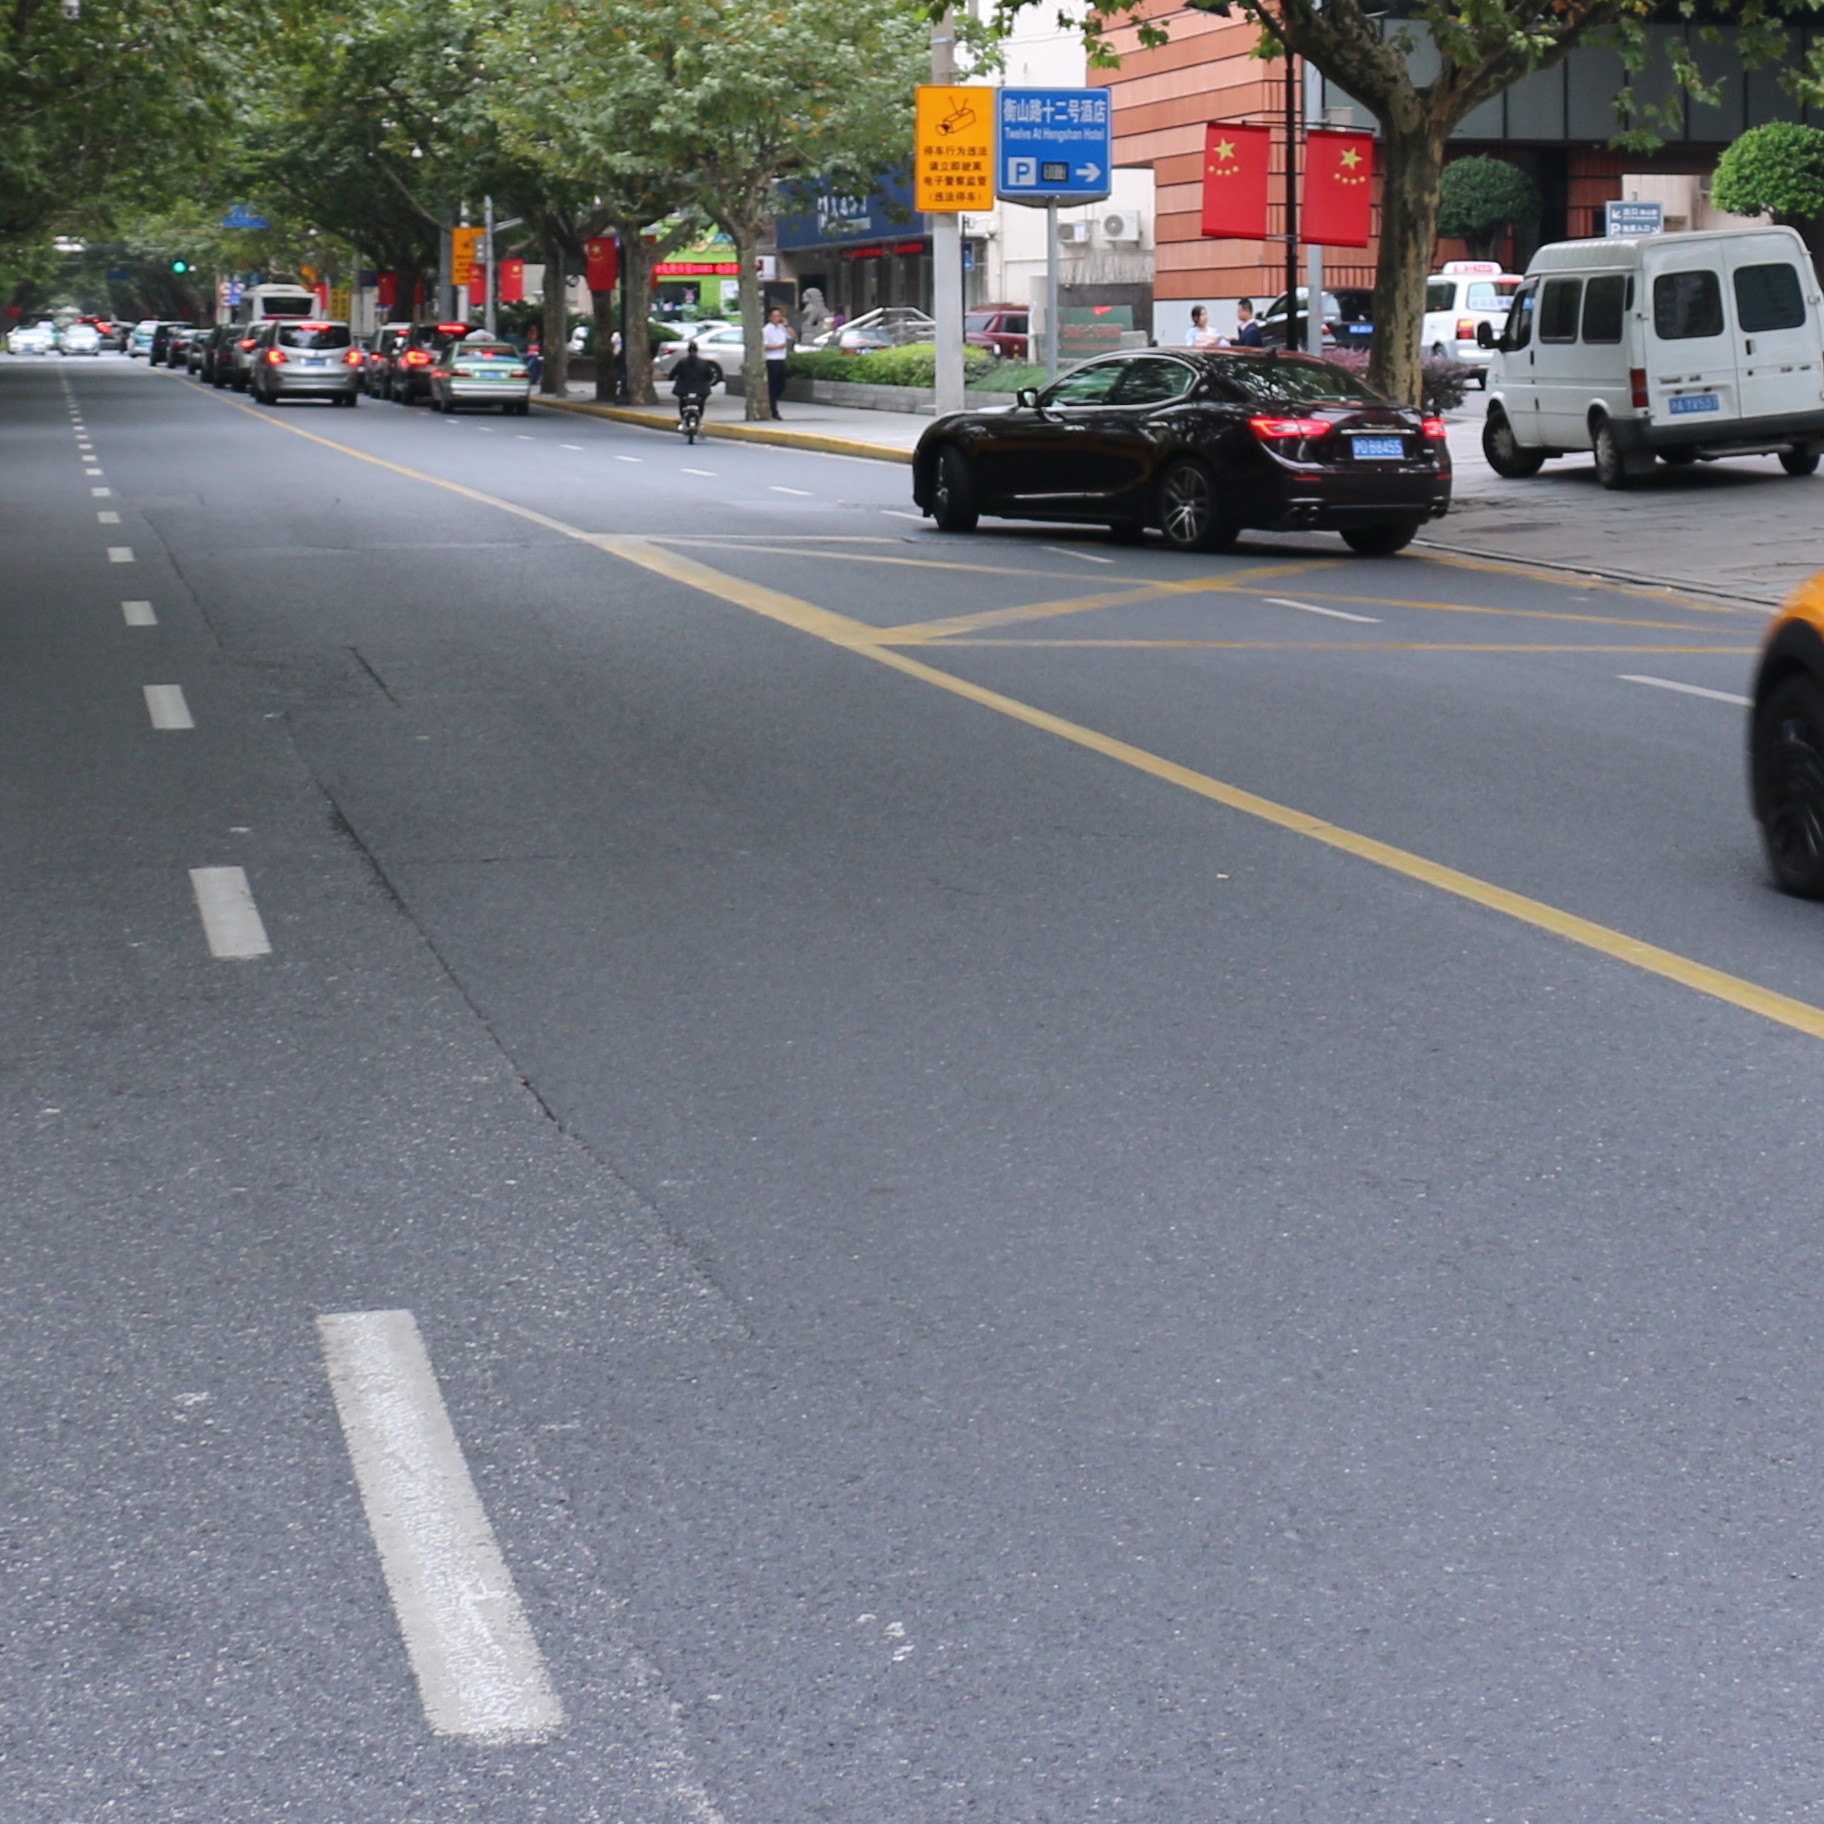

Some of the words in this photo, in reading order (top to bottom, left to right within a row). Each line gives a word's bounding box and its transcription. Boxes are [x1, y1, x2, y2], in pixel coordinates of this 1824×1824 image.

[1003, 97, 1107, 124] 衡山路十二号酒店
[1004, 126, 1032, 140] Twelve
[1033, 127, 1042, 139] At
[1043, 127, 1082, 143] Hengshan
[1083, 127, 1105, 140] Hotel
[924, 146, 988, 156] 停车行为违法
[929, 161, 982, 172] 请立即驶离
[1016, 162, 1030, 183] P
[924, 176, 987, 186] 电子警察监管
